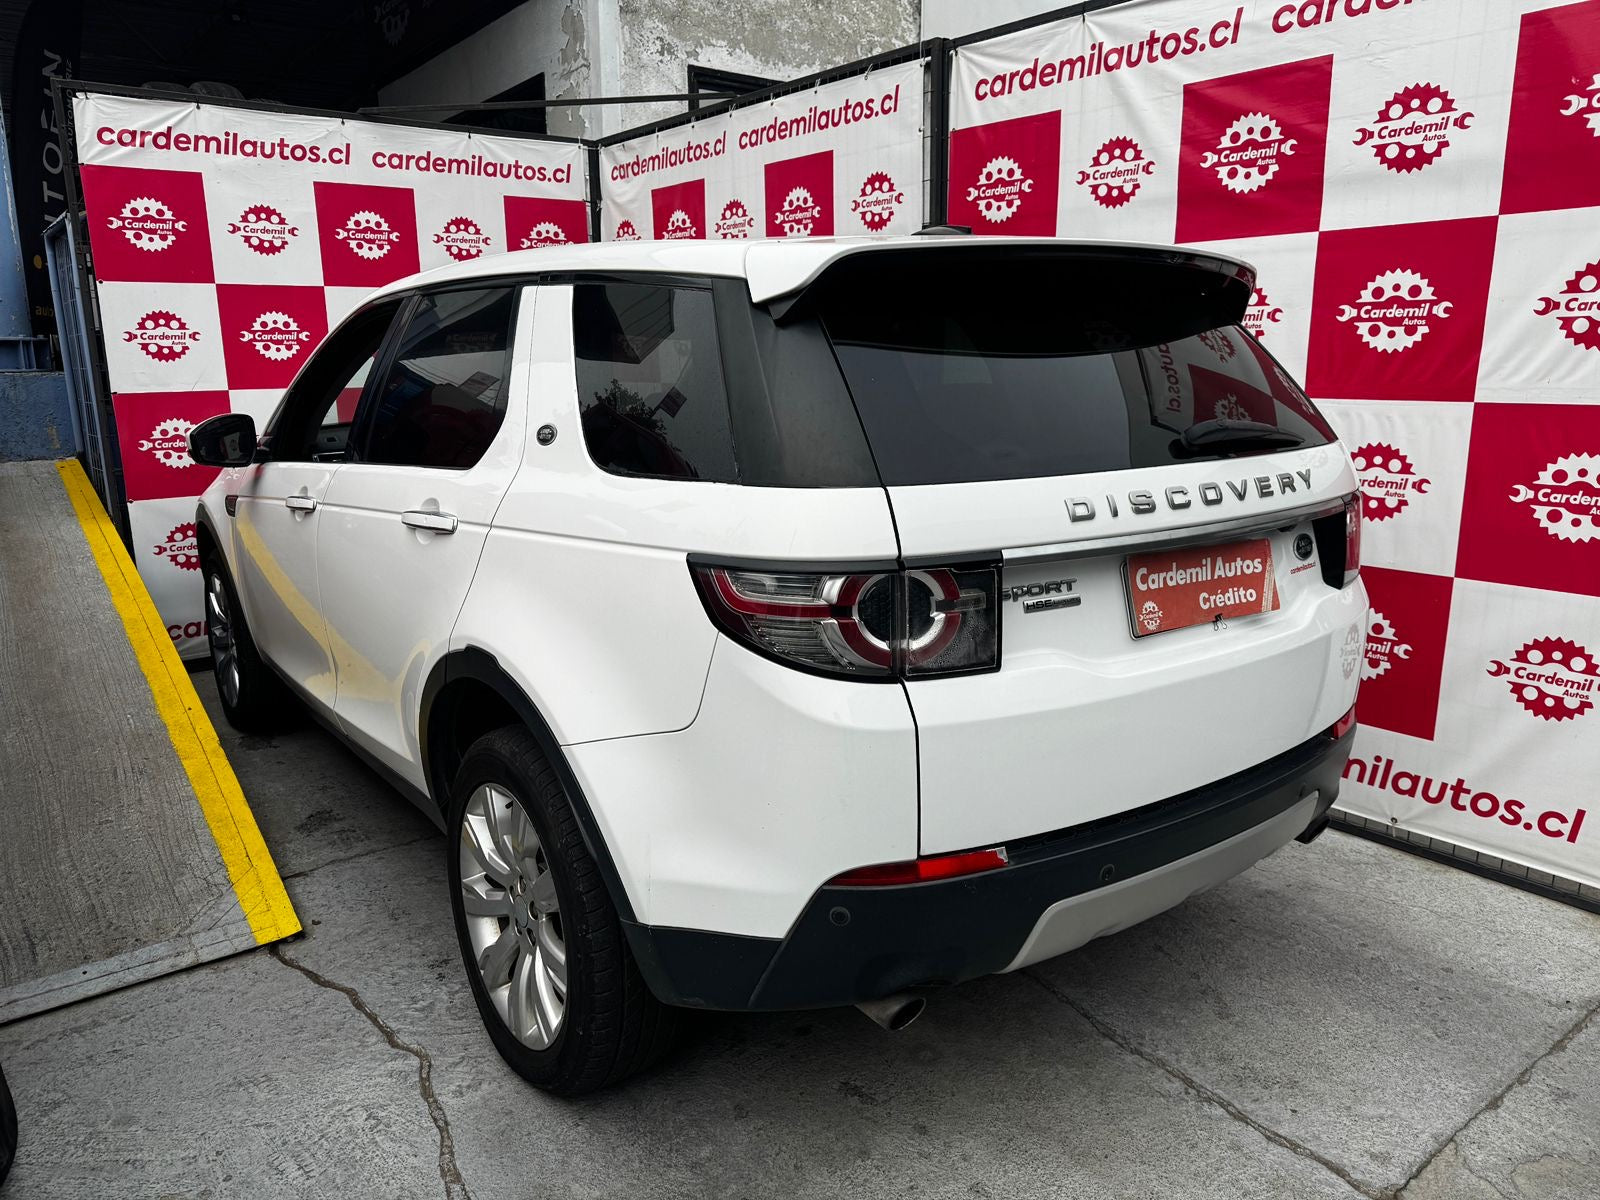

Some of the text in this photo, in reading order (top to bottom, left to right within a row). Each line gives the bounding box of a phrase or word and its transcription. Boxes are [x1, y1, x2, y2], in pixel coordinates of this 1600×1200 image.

[975, 7, 1244, 101] cardemilautos.cl
[739, 84, 900, 150] cardemilautos.cl
[1377, 115, 1450, 140] Cardemil
[1421, 133, 1447, 143] Autos
[97, 126, 351, 165] cardemilautos.cl
[611, 130, 727, 181] cardemilautos.cl
[1220, 144, 1279, 165] Cardemil
[1256, 157, 1277, 166] Autos
[371, 150, 572, 184] cardemilautos.cl
[1092, 164, 1140, 182] Cardemil
[1122, 176, 1139, 184] Autos
[979, 181, 1020, 198] Cardemil
[861, 194, 894, 209] Cardemil
[125, 219, 173, 229] Cardemil
[243, 225, 286, 235] Cardemil
[349, 230, 389, 241] Cardemil
[445, 235, 481, 244] Cardemil
[1359, 302, 1430, 319] Cardemil
[1565, 298, 1600, 312] Car
[1402, 317, 1427, 326] Autos
[140, 332, 186, 341] Cardemil
[255, 331, 297, 341] Cardemil
[1360, 476, 1409, 490] rdemil
[1064, 468, 1311, 523] DISCOVERY
[1384, 490, 1406, 498] Autos
[1136, 556, 1263, 592] Cardemil Autos
[1026, 599, 1053, 610] HSE
[1199, 586, 1257, 610] Crédito
[1367, 651, 1388, 661] Autos
[1514, 666, 1595, 692] Cardemil
[1562, 688, 1590, 700] Autos
